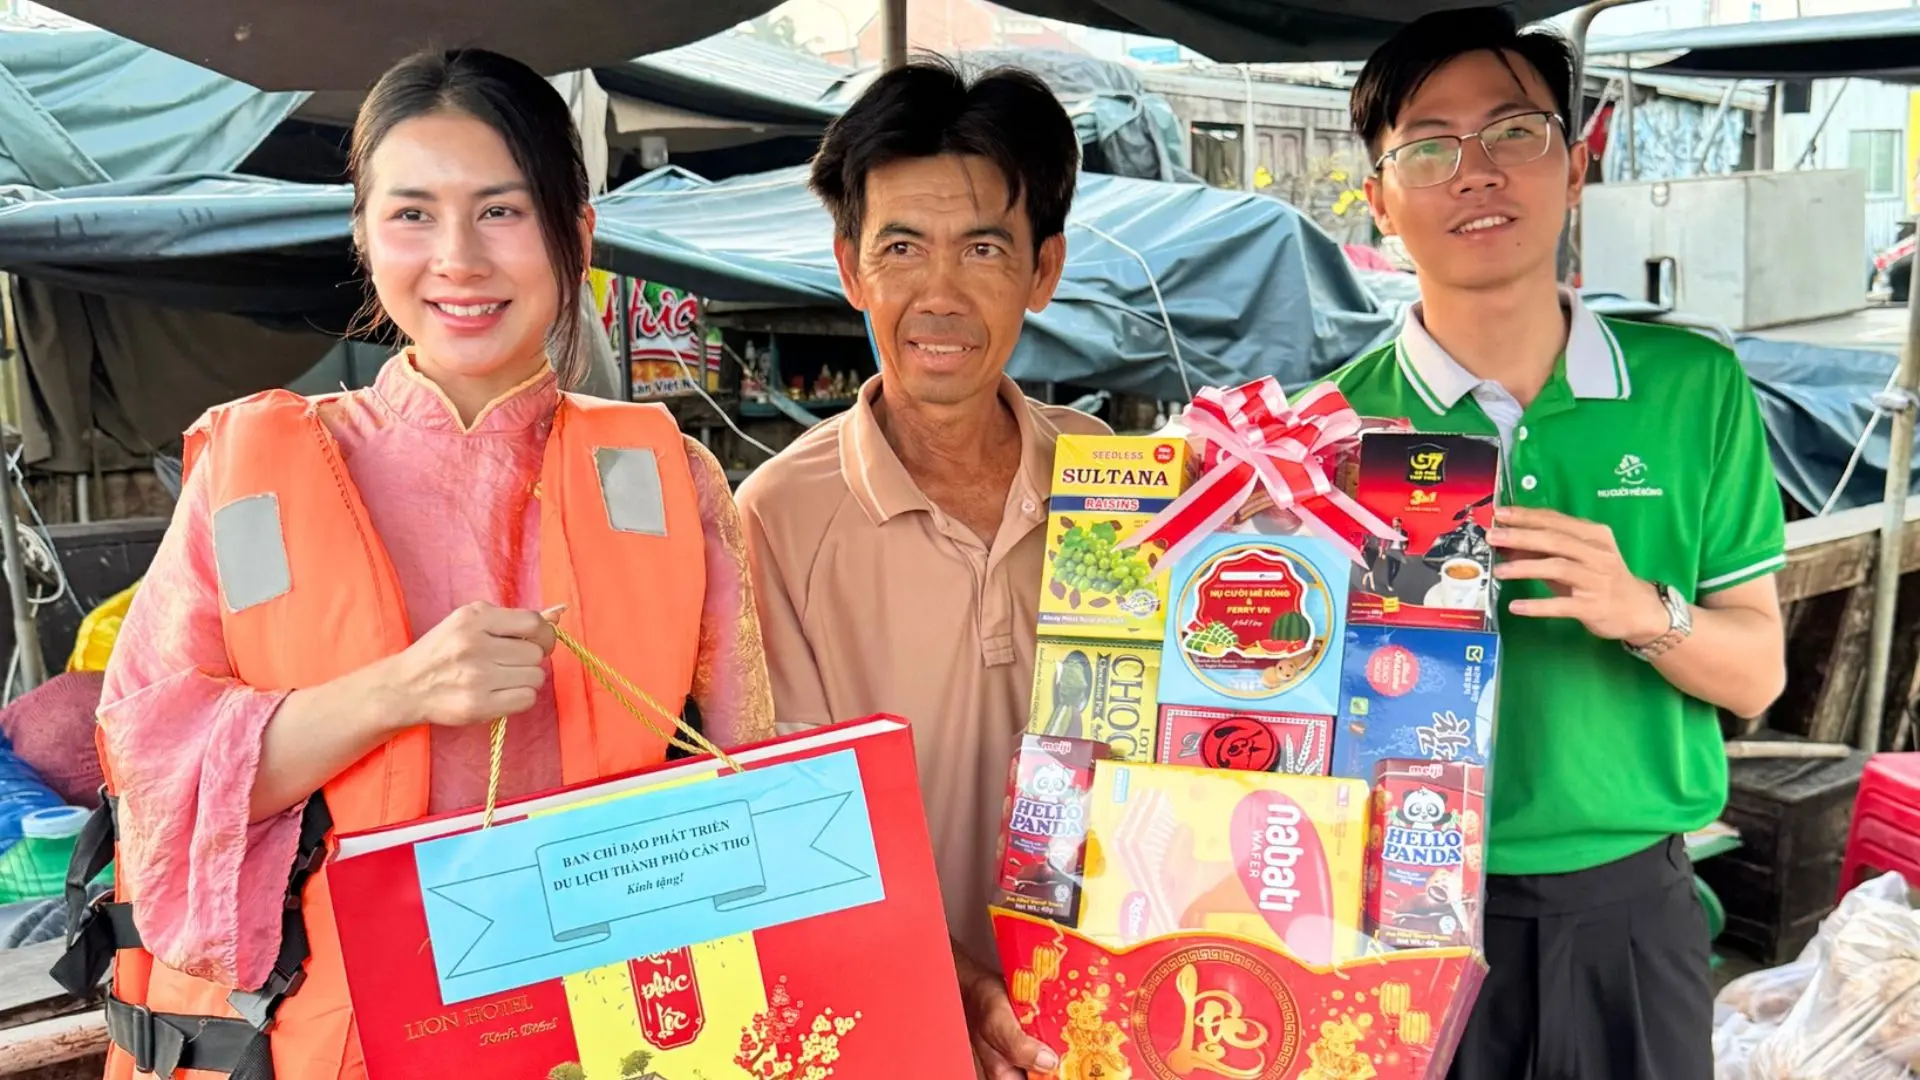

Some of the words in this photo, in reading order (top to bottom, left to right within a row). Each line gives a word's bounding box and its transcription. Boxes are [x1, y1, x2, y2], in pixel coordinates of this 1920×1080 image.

[1092, 450, 1144, 460] SEEDLESS
[1411, 452, 1443, 470] G7
[1062, 468, 1169, 486] SULTANA
[1085, 498, 1139, 511] RAISINS
[1226, 606, 1255, 614] FERRY
[1257, 606, 1271, 614] VN
[1105, 654, 1145, 761] CHOC
[1041, 741, 1072, 755] meiji
[1409, 764, 1443, 779] meiji
[1016, 800, 1083, 821] HELLO
[1011, 815, 1082, 835] PANDA
[562, 852, 591, 868] BAN
[593, 843, 618, 861] CHỈ
[620, 839, 649, 856] ĐẠO
[652, 828, 687, 848] PHÁT
[689, 820, 731, 837] TRIỂN
[1388, 828, 1461, 847] HELLO
[553, 877, 573, 891] DU
[576, 868, 609, 886] LỊCH
[611, 857, 659, 877] THÀNH
[661, 847, 689, 867] PHỐ
[692, 842, 720, 858] CẦN
[722, 835, 750, 852] THƠ
[1248, 829, 1264, 878] WAFER
[1259, 803, 1304, 912] nabati
[1384, 843, 1462, 864] PANDA
[627, 880, 653, 895] Kính
[655, 872, 684, 890] tặng!
[404, 1011, 460, 1040] LION
[463, 995, 534, 1026] HOTEL
